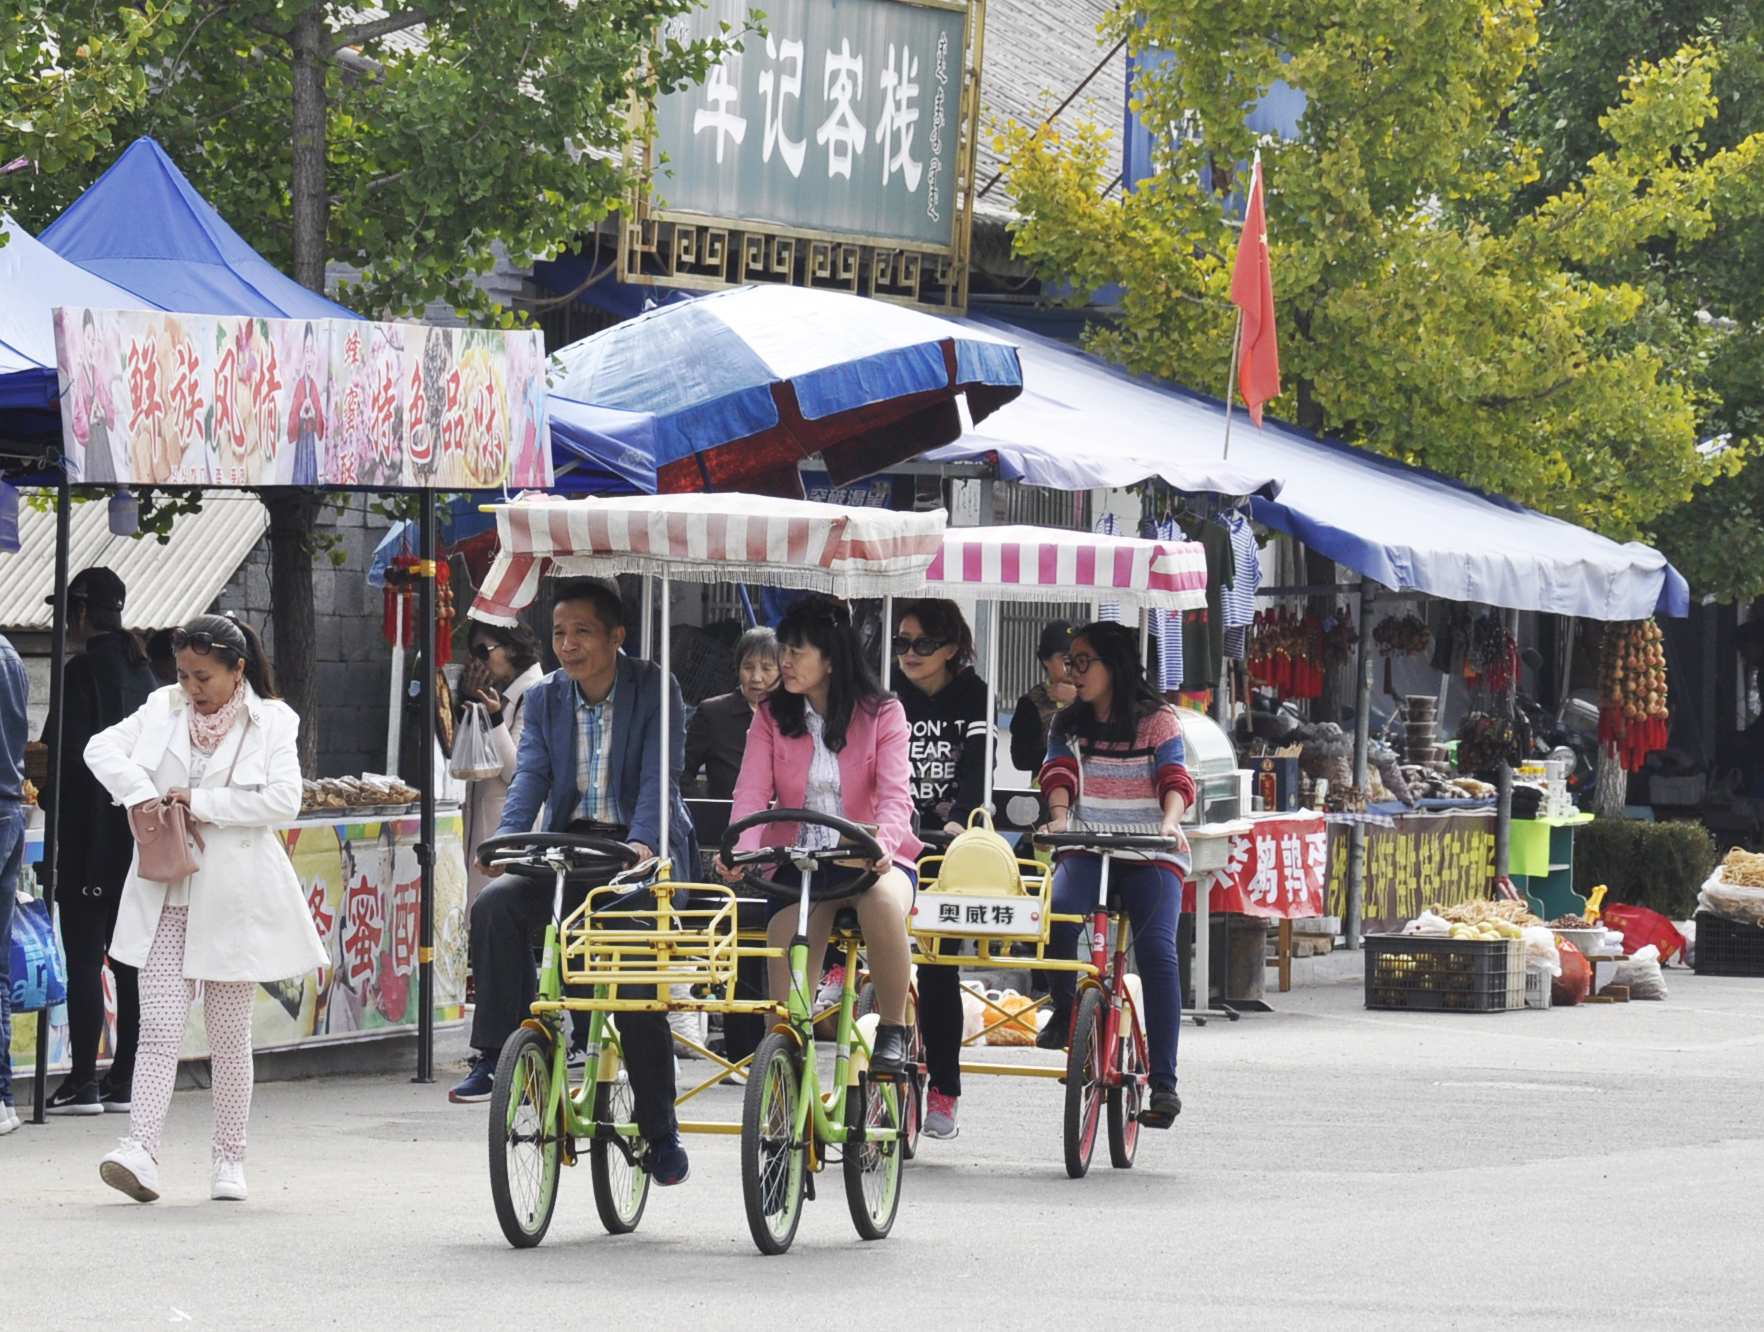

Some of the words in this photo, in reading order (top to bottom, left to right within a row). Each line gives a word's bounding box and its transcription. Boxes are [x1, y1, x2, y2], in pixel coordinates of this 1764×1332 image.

[126, 335, 282, 463] 鲜族风情
[339, 328, 362, 485] 蜂蜜酥
[371, 358, 504, 466] 特色品味
[908, 741, 951, 758] EAR
[909, 762, 956, 778] AYBE
[909, 783, 949, 799] ABY
[939, 903, 1014, 925] 奥威特
